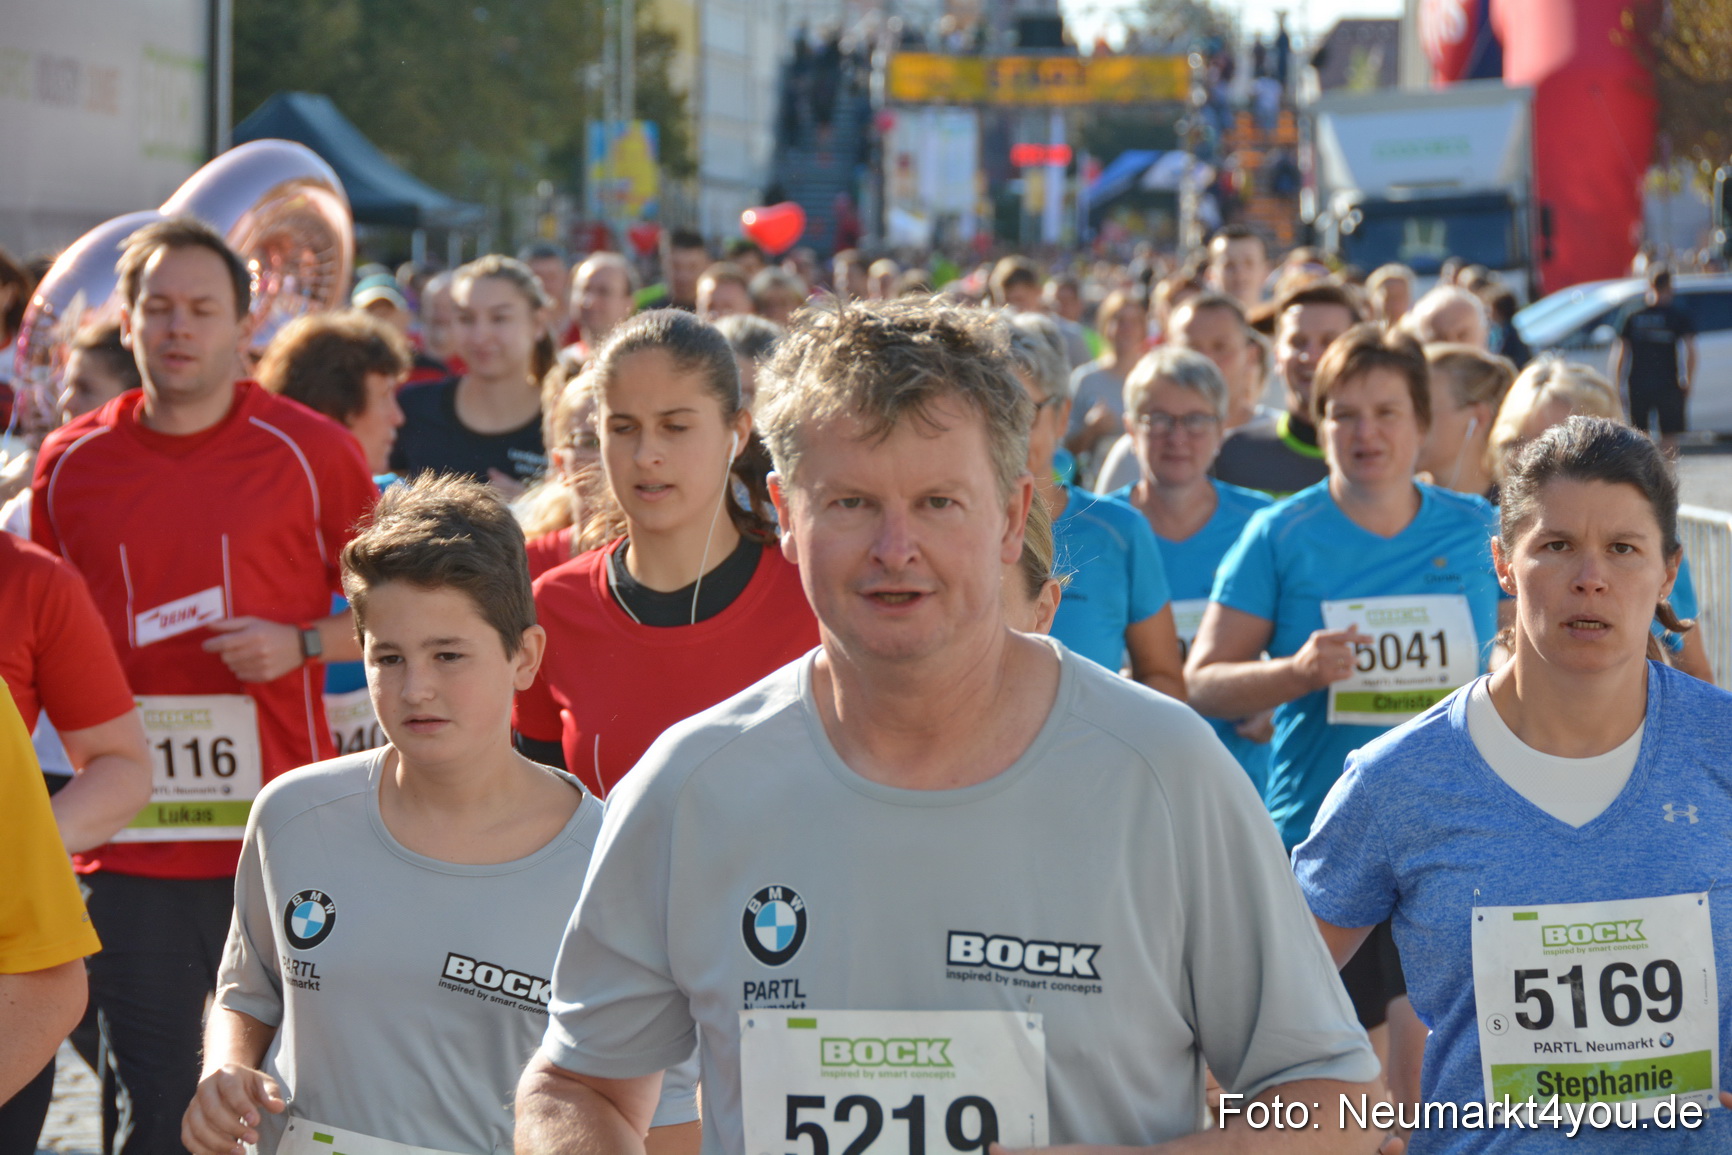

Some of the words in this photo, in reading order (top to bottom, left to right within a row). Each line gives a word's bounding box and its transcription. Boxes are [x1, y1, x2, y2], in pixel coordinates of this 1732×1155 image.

[1355, 630, 1448, 672] 5041
[147, 737, 236, 778] 116
[158, 805, 213, 824] Lukas
[1541, 919, 1647, 947] BOCK
[946, 930, 1102, 980] BOCK
[1543, 947, 1575, 956] inspired
[1576, 946, 1586, 954] by
[1588, 944, 1611, 953] smart
[1613, 942, 1649, 952] concepts
[438, 978, 476, 997] inspired
[476, 990, 488, 1001] by
[491, 996, 517, 1009] smart
[441, 952, 551, 1007] BOCK
[743, 979, 806, 1001] PARTL
[946, 969, 992, 983] inspired
[995, 973, 1009, 986] by
[1012, 976, 1047, 990] smart
[1050, 980, 1103, 995] concepts
[1514, 959, 1683, 1031] 5169
[1493, 1020, 1502, 1031] S
[820, 1037, 954, 1067] BOCK
[1534, 1041, 1583, 1053] PARTL
[1586, 1038, 1655, 1053] Neumarkt
[820, 1068, 860, 1080] inspired
[862, 1069, 875, 1081] by
[878, 1069, 909, 1080] smart
[910, 1069, 956, 1081] concepts
[1536, 1065, 1674, 1102] Stephanie
[785, 1094, 999, 1155] 5219
